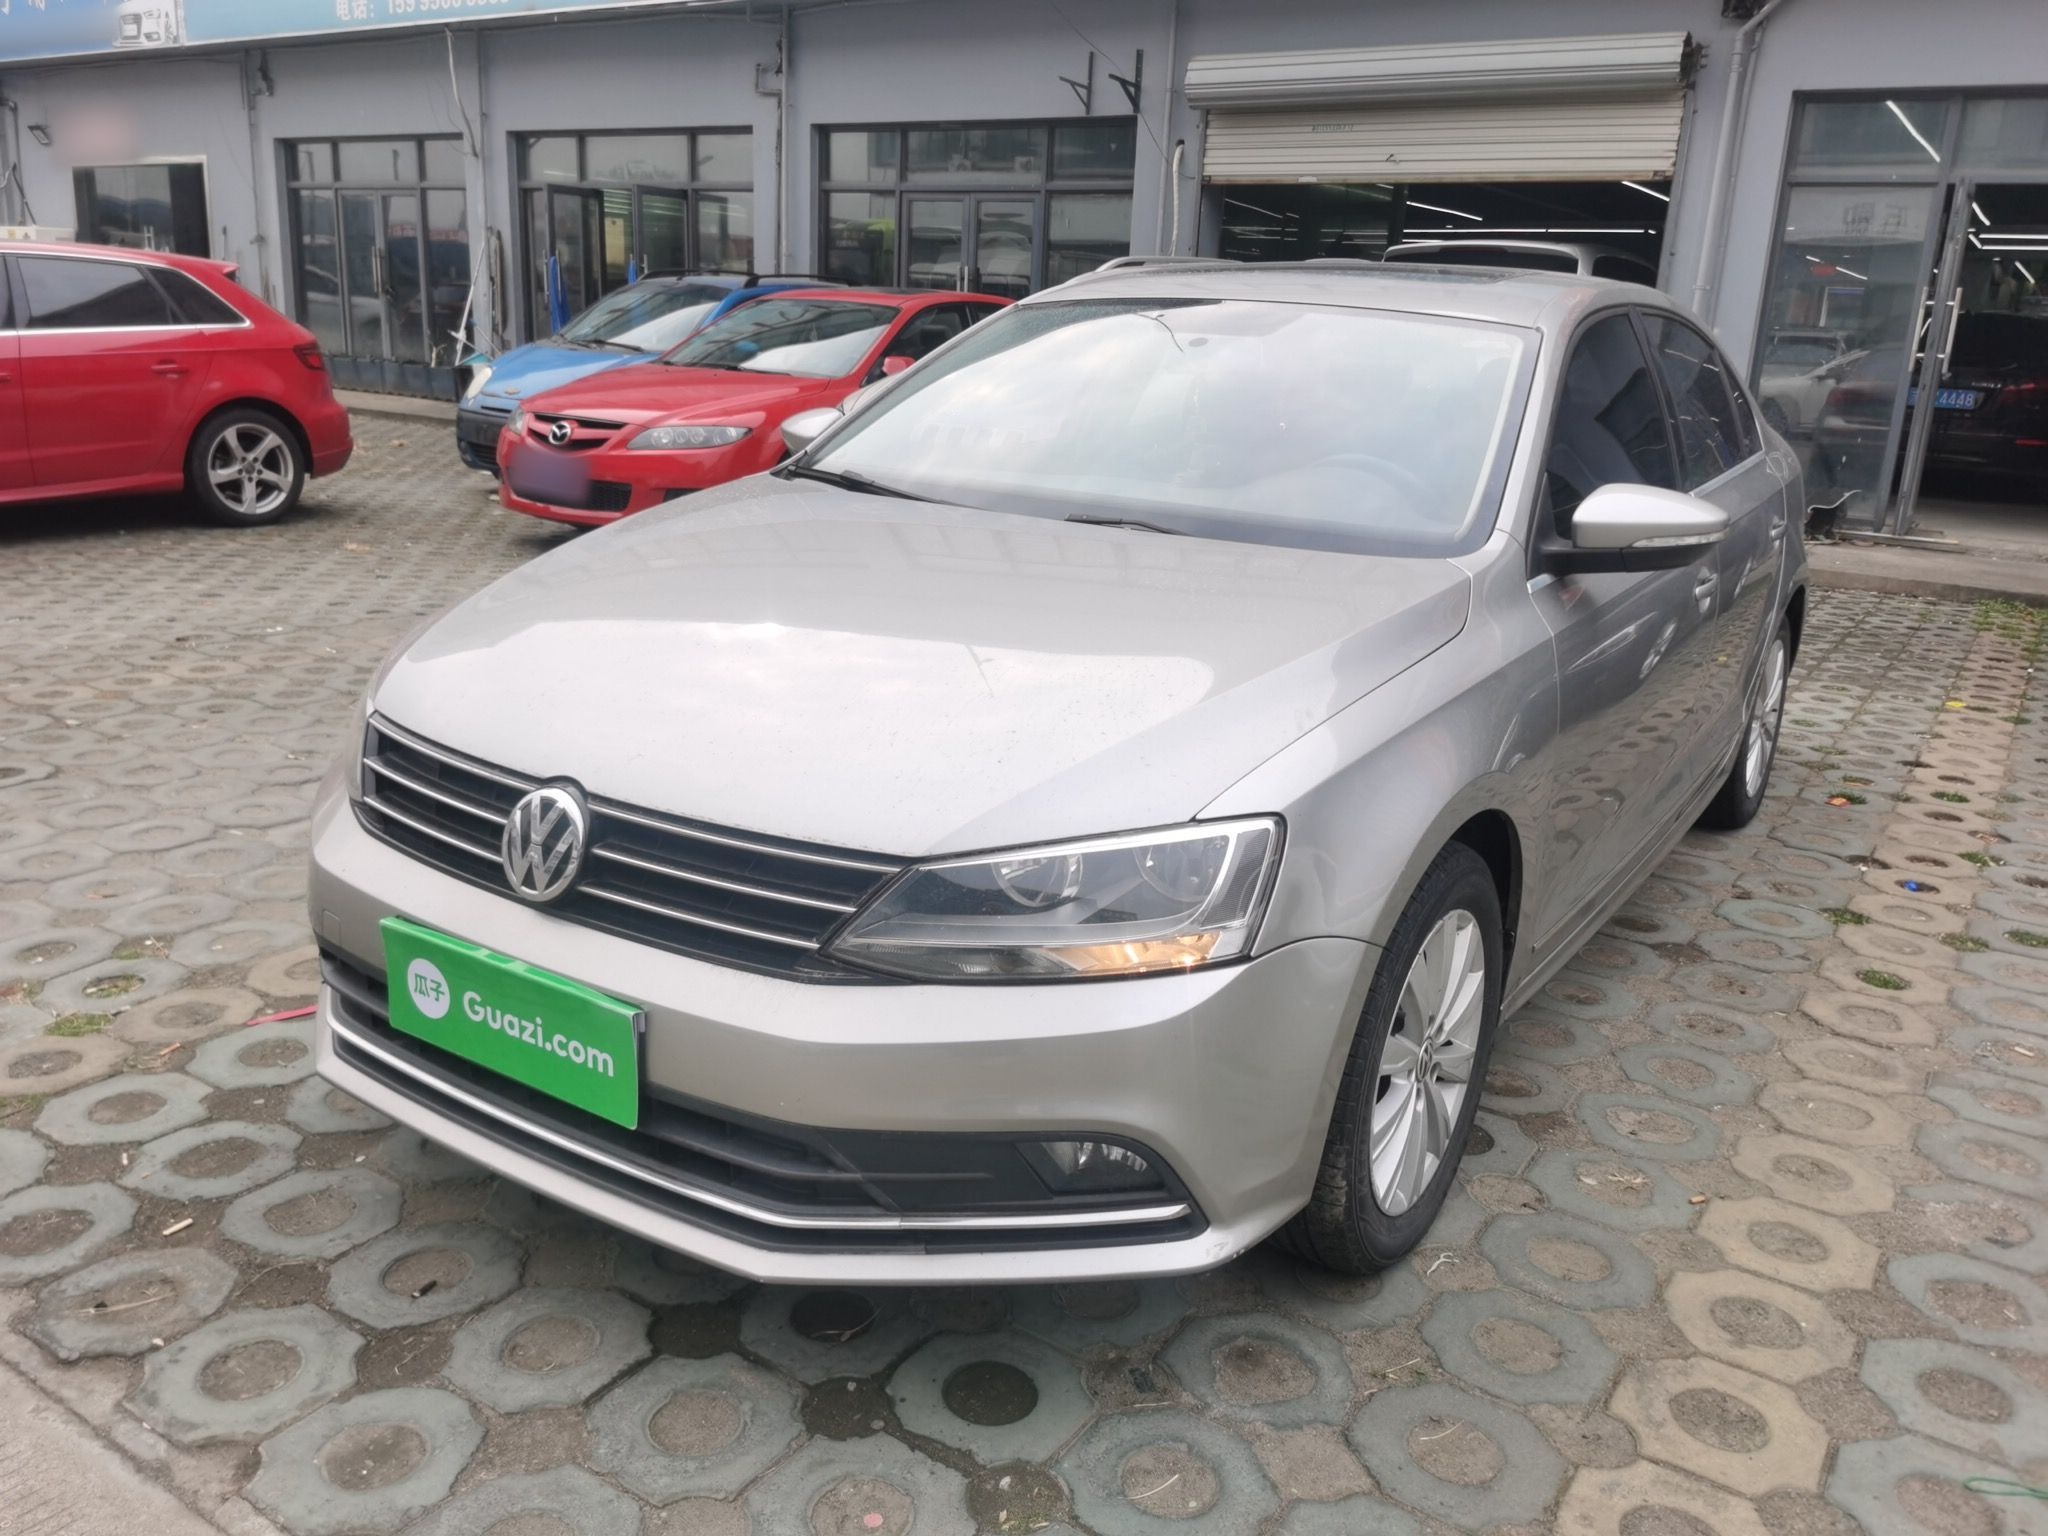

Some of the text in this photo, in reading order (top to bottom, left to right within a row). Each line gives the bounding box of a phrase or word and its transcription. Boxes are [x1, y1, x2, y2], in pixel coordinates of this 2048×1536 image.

[1936, 391, 1974, 407] 4448
[414, 973, 445, 1002] 瓜子
[463, 991, 614, 1077] Guazi.com
